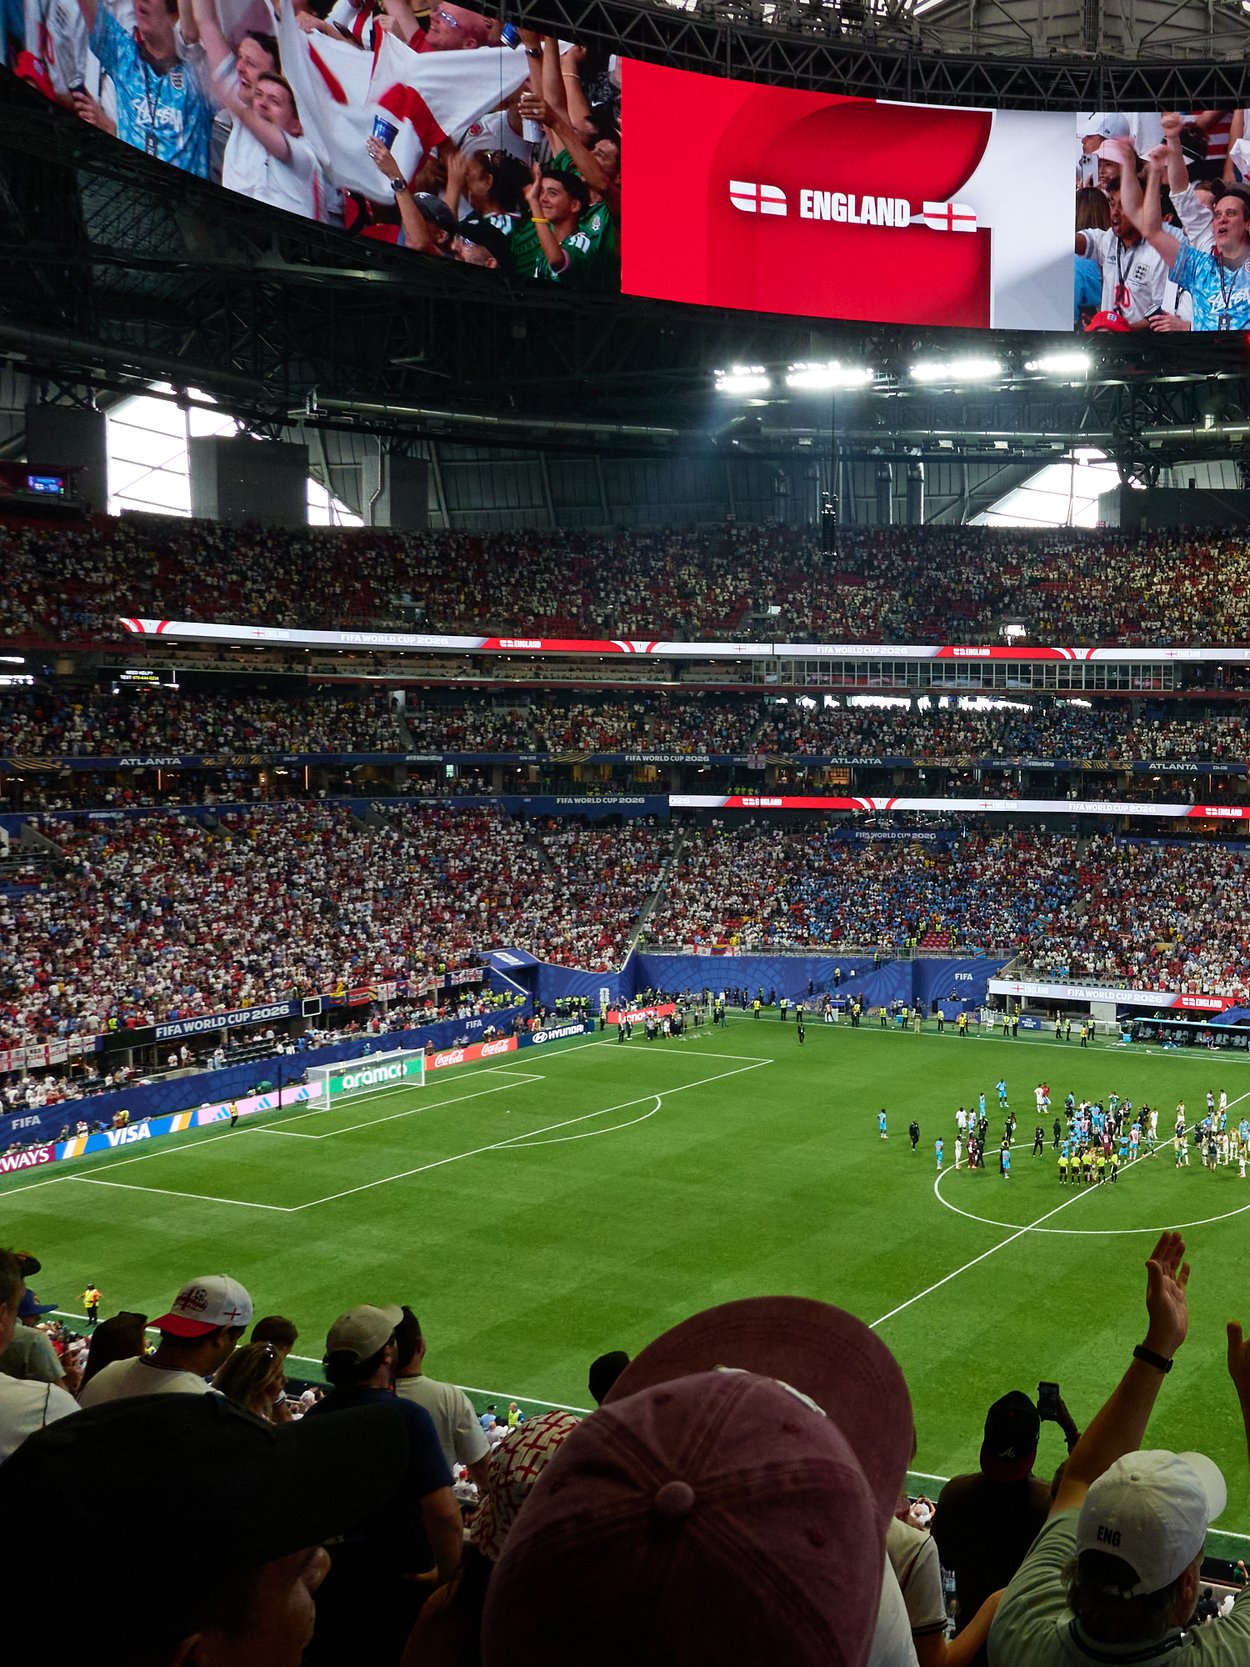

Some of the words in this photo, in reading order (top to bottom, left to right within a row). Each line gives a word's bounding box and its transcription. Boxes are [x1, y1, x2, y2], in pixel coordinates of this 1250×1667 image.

[800, 189, 910, 228] ENGLAND
[362, 634, 395, 642] WORLD
[514, 640, 541, 648] ENGLAND
[120, 757, 182, 766] ATLANTA
[1087, 804, 1112, 812] WORLD
[1218, 808, 1242, 817] ENGLAND
[955, 973, 973, 981] FIFA
[1068, 989, 1086, 997] FIFA
[1087, 990, 1115, 999] WORLD
[1116, 992, 1132, 1001] CUP
[1134, 994, 1162, 1003] 2026
[1196, 998, 1222, 1008] ENGLAND
[156, 1025, 183, 1038] FIFA
[183, 1017, 226, 1032] WORLD
[228, 1012, 250, 1024] CUP
[251, 1004, 289, 1020] 2026
[466, 1019, 482, 1030] FIFA
[548, 1024, 584, 1040] HYUNDAI
[480, 1036, 509, 1057] Coca-Cola
[434, 1048, 464, 1068] Coca-Cola
[342, 1061, 408, 1090] aramco
[12, 1115, 41, 1130] FIFA
[104, 1123, 151, 1147] VISA
[0, 1148, 50, 1172] WAYS
[1097, 1525, 1121, 1548] ENG
